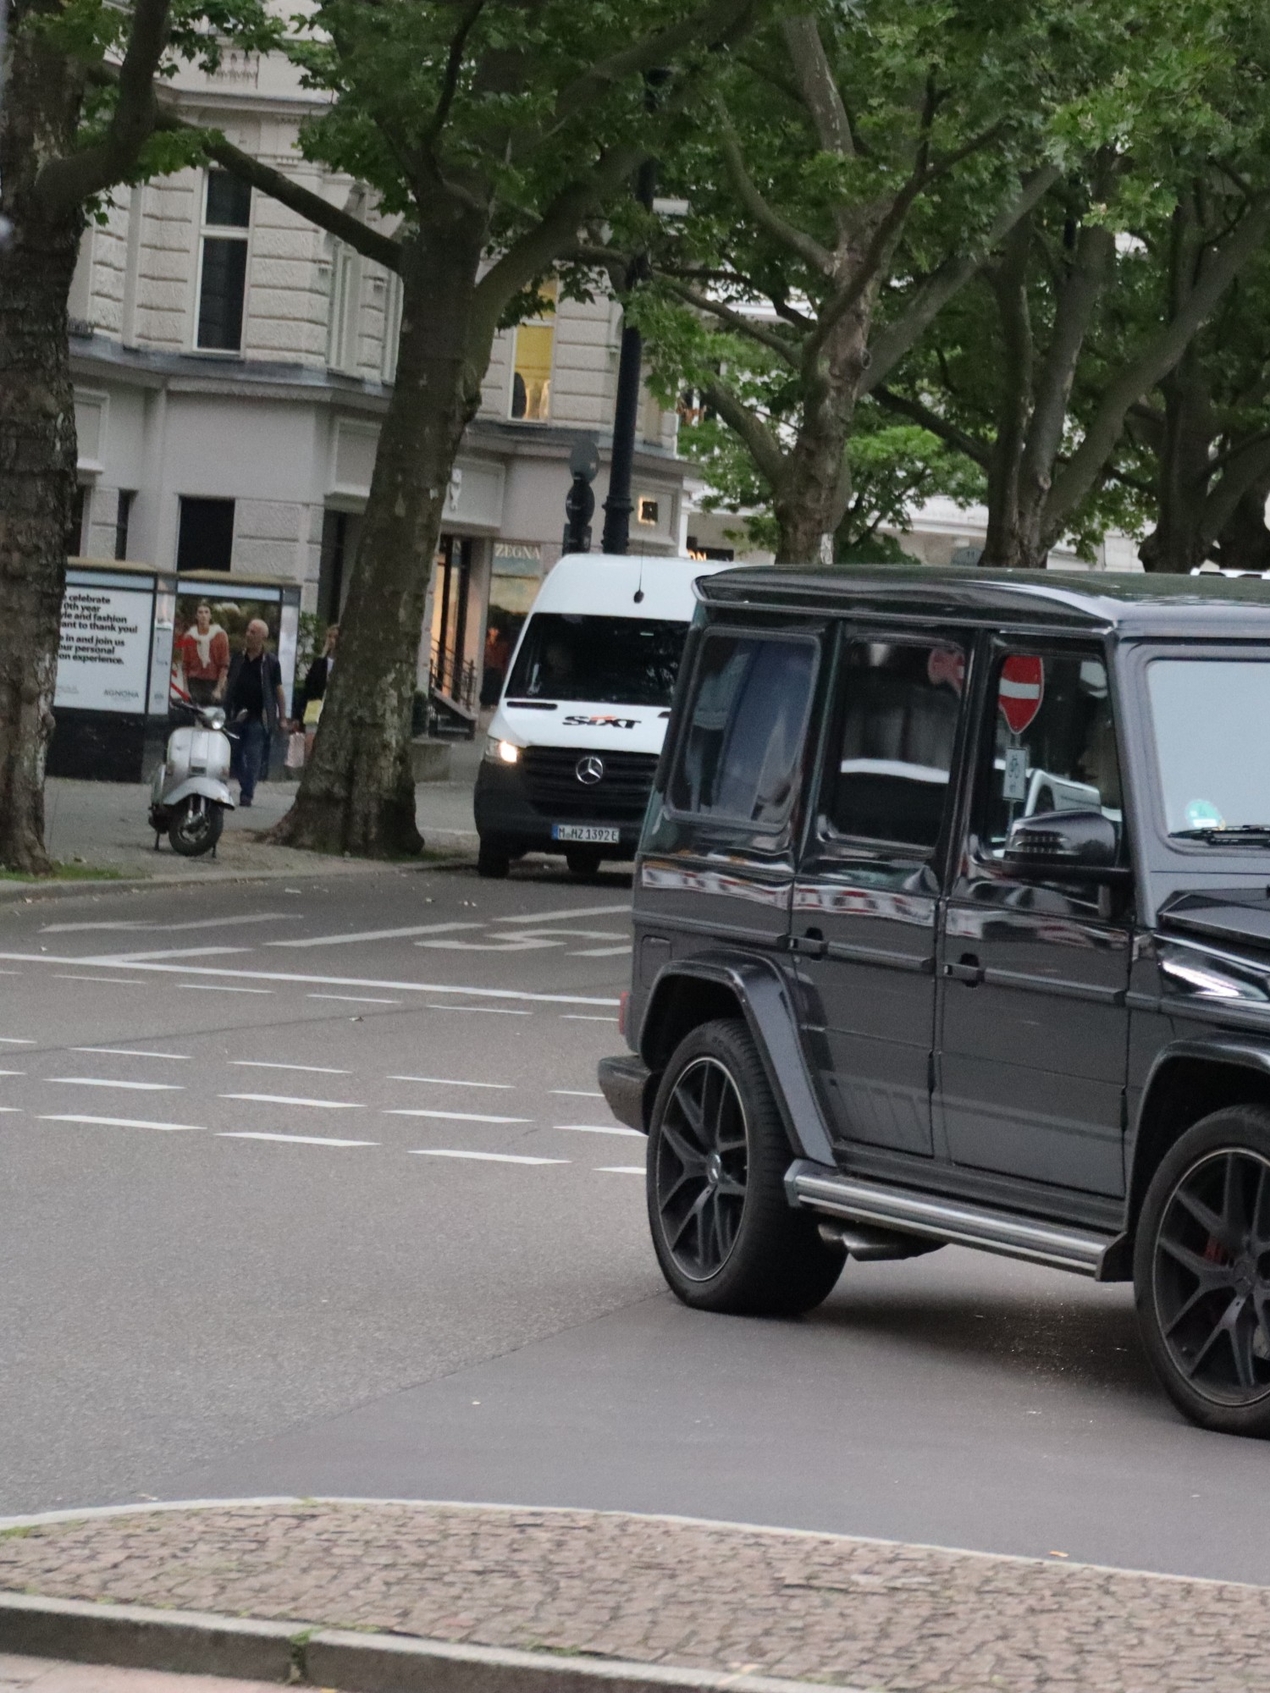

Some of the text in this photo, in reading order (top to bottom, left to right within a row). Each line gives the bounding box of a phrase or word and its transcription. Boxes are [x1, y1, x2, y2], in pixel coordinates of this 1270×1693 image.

[493, 543, 540, 560] ZEGNA
[69, 594, 111, 604] celebrate
[81, 604, 101, 613] year
[94, 614, 127, 624] fashion
[79, 621, 88, 629] to
[90, 622, 116, 632] thank
[118, 626, 138, 634] you!
[66, 633, 74, 641] in
[76, 635, 94, 644] and
[95, 636, 112, 646] join
[75, 645, 115, 654] personal
[562, 716, 641, 729] SIXT
